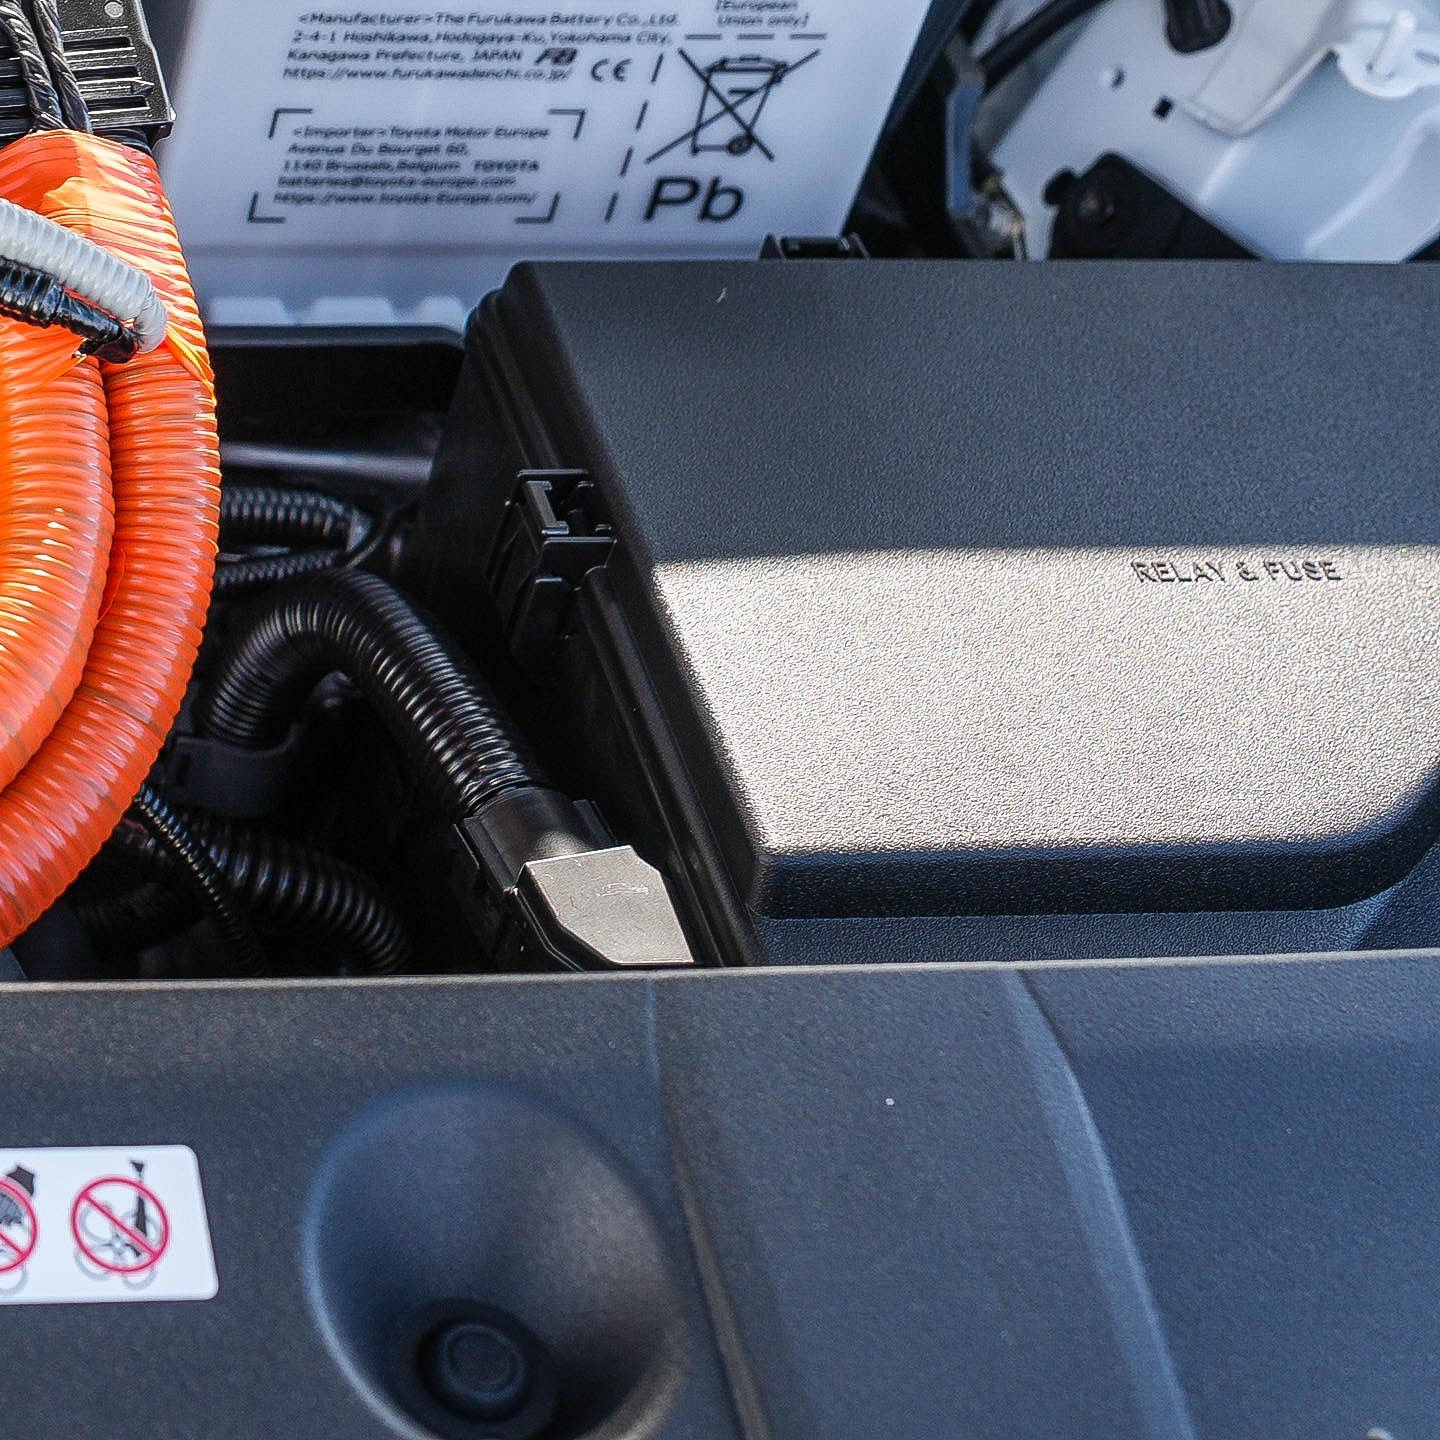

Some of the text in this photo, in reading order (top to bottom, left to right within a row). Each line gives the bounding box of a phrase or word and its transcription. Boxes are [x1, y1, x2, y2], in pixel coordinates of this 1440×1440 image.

[287, 49, 370, 63] Kanagawa
[471, 48, 523, 61] JAPAN
[642, 175, 745, 223] Pb
[1130, 560, 1342, 583] RELAY & FUSE
